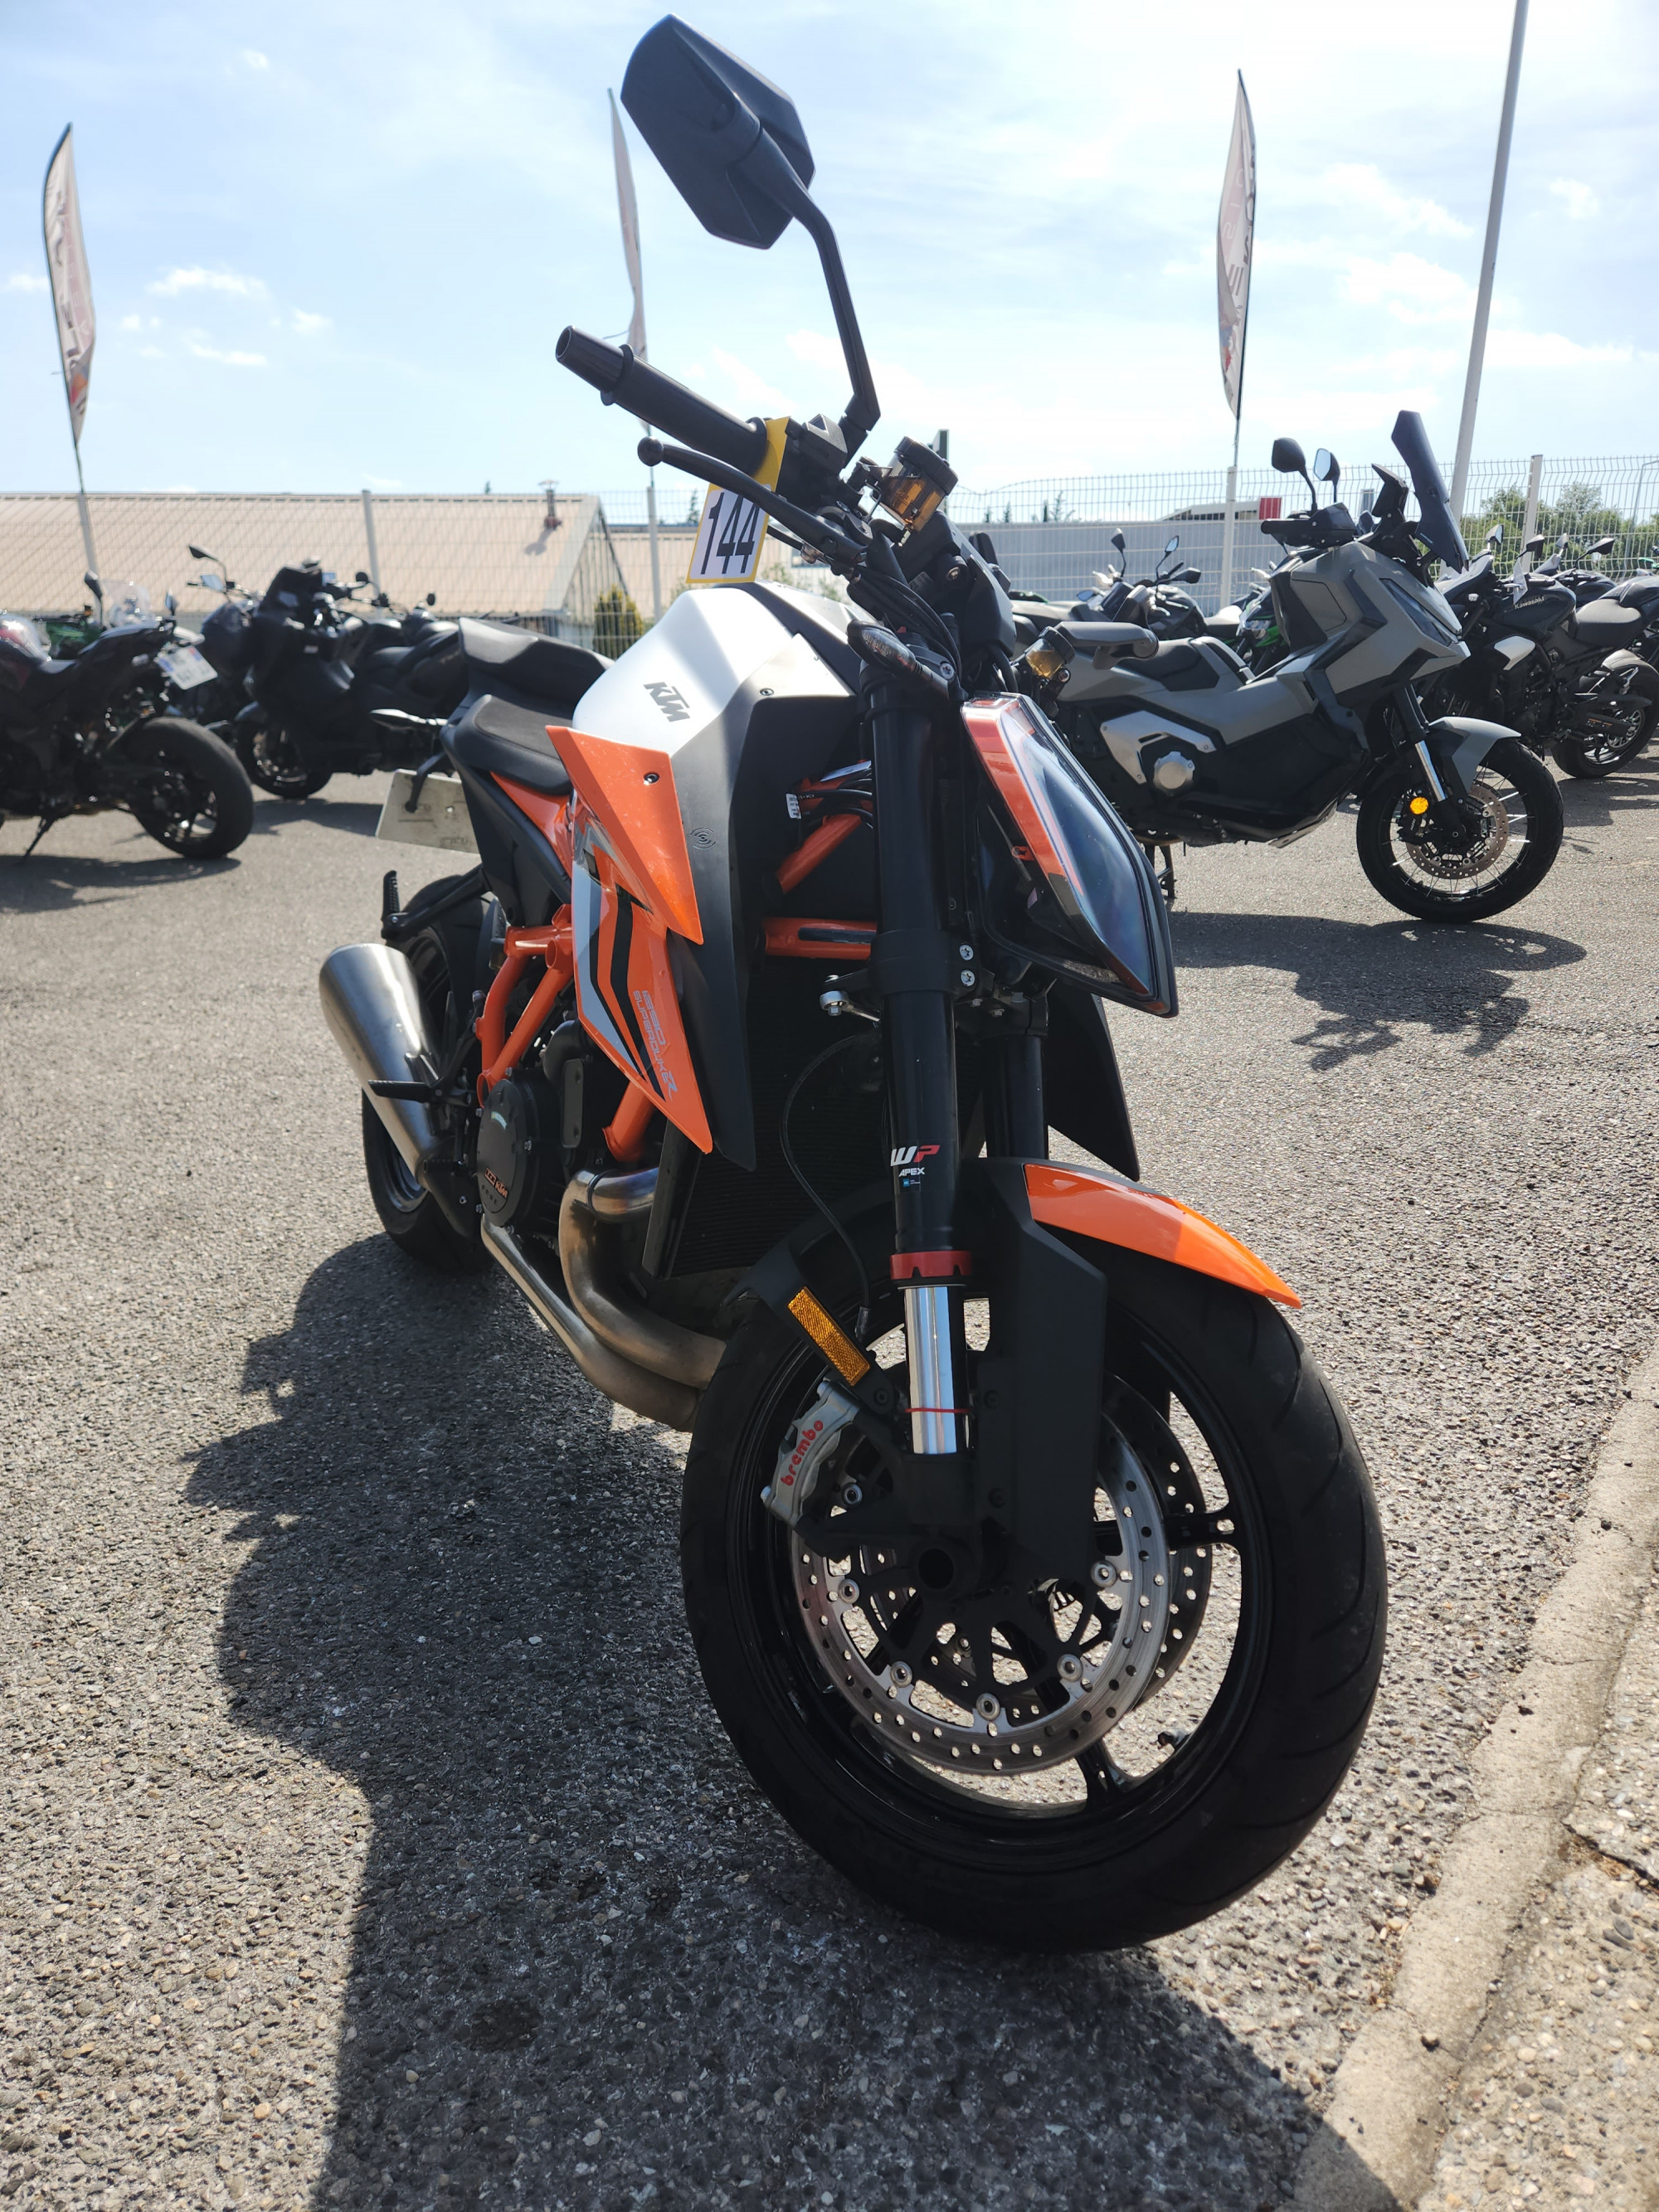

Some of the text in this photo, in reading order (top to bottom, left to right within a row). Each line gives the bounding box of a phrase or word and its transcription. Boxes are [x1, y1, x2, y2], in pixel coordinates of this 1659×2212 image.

[700, 492, 760, 574] 144
[1515, 596, 1545, 610] Kawasaki
[643, 681, 690, 722] KTM
[890, 1145, 940, 1167] WP
[898, 1167, 925, 1177] APEX
[781, 1420, 824, 1485] brembo
